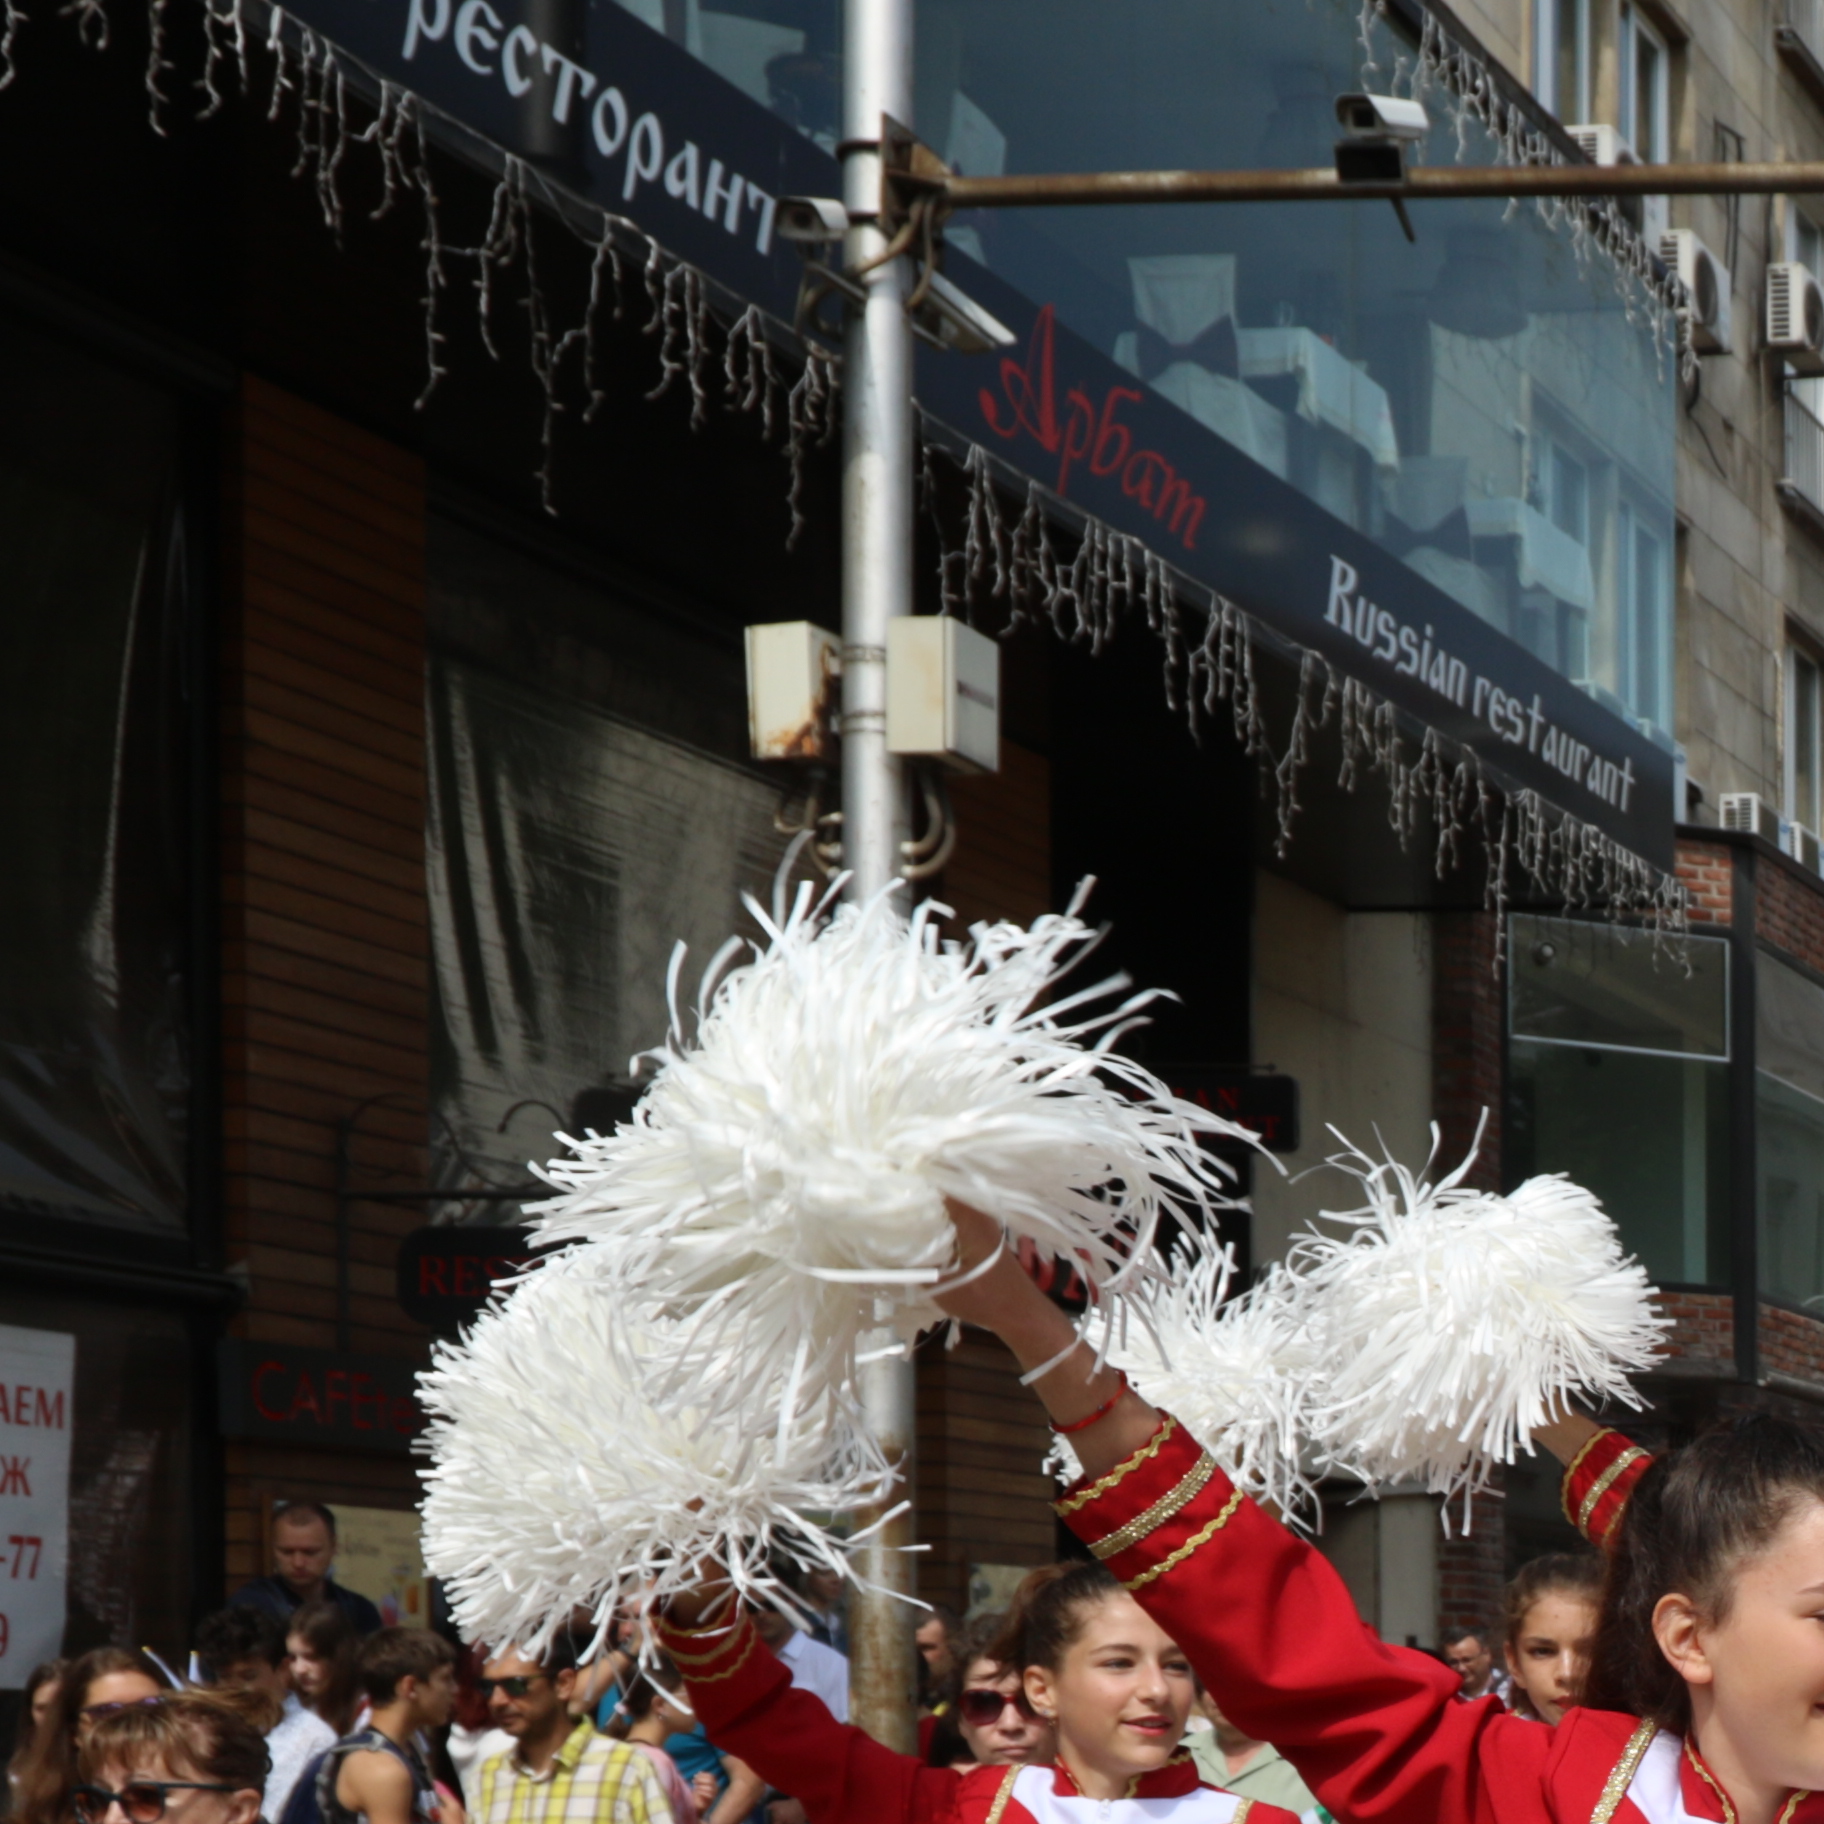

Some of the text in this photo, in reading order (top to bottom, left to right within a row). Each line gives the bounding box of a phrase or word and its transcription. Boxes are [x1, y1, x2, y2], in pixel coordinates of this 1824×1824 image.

[979, 302, 1207, 550] Арбат
[1323, 553, 1635, 814] Russian restaurant
